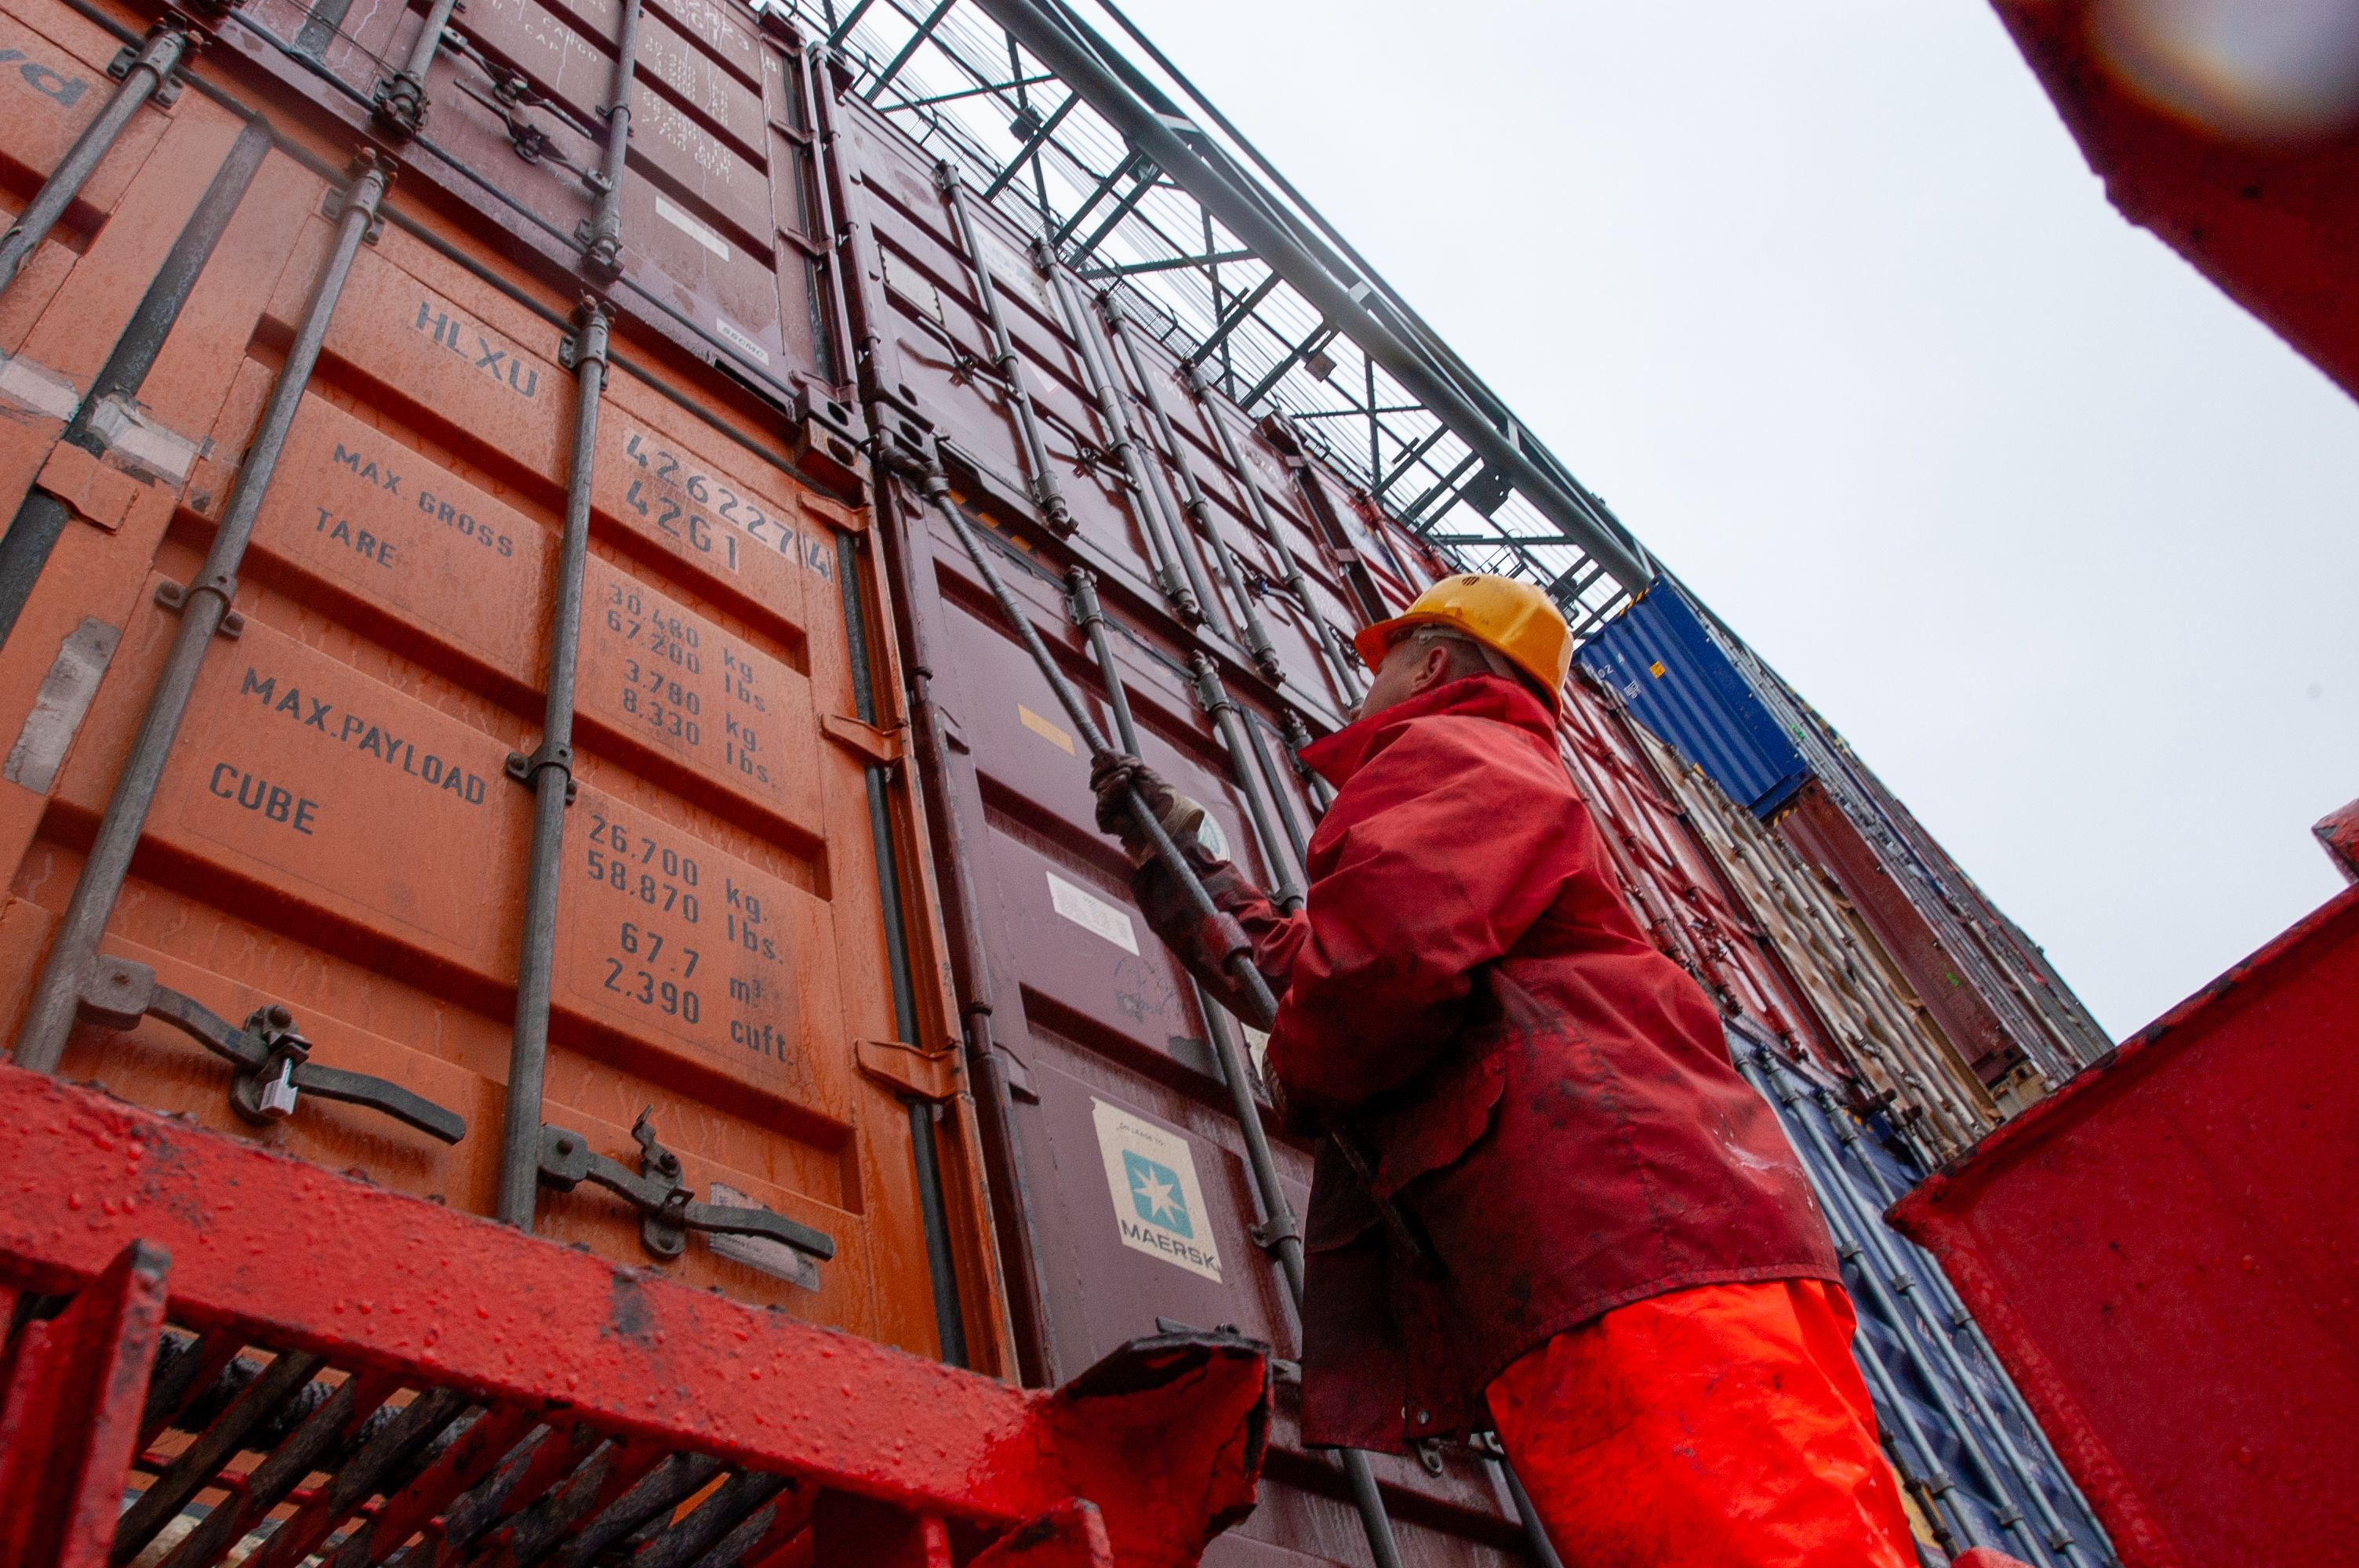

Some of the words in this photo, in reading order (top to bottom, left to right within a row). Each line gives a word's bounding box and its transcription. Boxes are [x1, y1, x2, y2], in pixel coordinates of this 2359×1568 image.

[416, 301, 538, 397] HLXU
[418, 491, 514, 557] GROSS
[625, 478, 738, 571] 42G1
[626, 434, 794, 555] 426227
[315, 506, 398, 570] TARE
[607, 610, 701, 674] 67.200
[609, 583, 700, 648] 30.480
[622, 687, 700, 746] 8.330
[624, 659, 700, 716] 3.780
[209, 762, 319, 836] CUBE
[589, 815, 698, 887] 26.700
[588, 849, 699, 924] 58.870
[620, 922, 700, 979] 67.7
[604, 957, 700, 1025] 2.390
[1120, 1218, 1221, 1273] MAERSK
